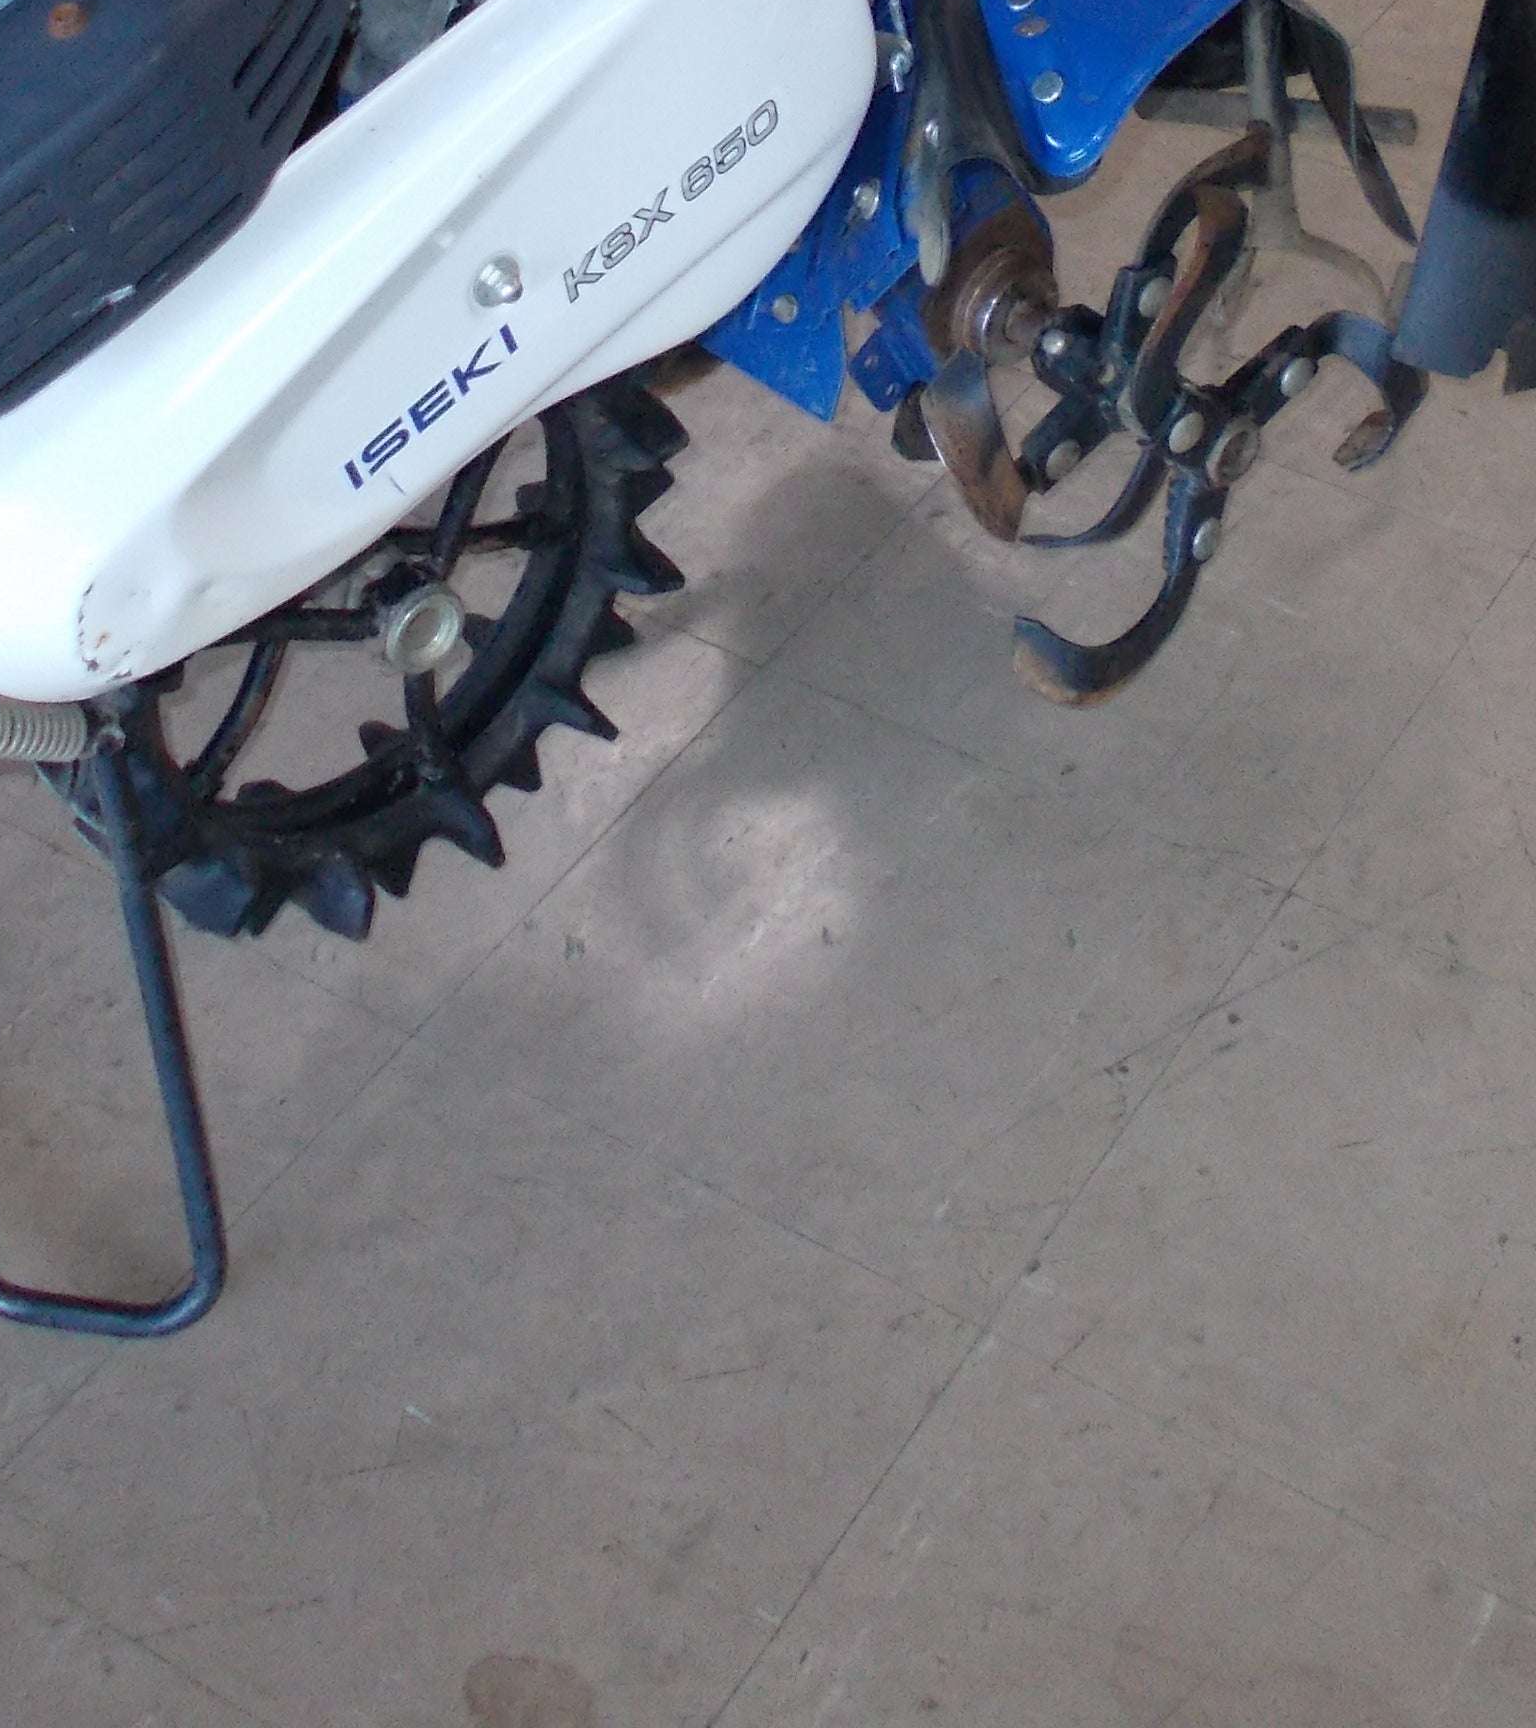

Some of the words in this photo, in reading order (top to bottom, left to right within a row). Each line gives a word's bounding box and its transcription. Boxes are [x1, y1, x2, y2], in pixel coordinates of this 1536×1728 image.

[562, 185, 677, 304] KSX
[680, 98, 779, 203] 650
[343, 322, 520, 491] ISEKI
